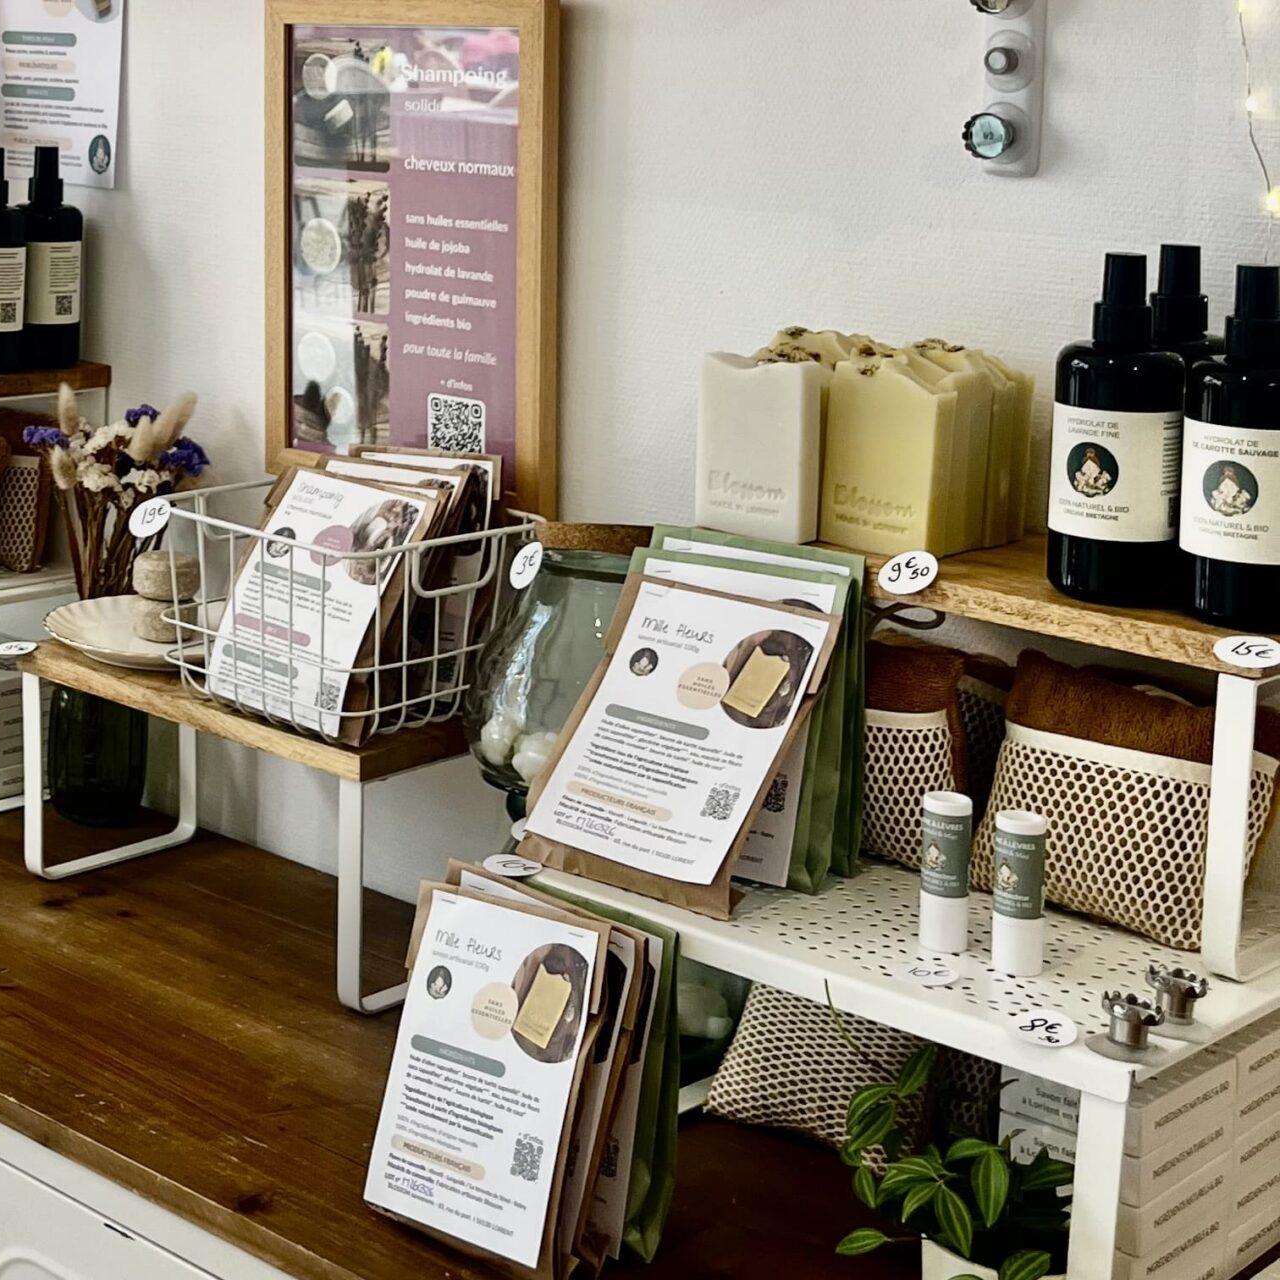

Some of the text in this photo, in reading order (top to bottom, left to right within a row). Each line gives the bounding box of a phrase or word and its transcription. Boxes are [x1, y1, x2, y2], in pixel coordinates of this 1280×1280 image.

[400, 64, 508, 89] Shampoing
[404, 155, 515, 177] cheveux normaux
[405, 213, 509, 233] sans huiles essentielles
[405, 236, 471, 255] huile de jojoba
[405, 261, 494, 283] hydrolat de lavande
[405, 288, 497, 309] poudre de guimauve
[405, 310, 472, 331] ingrédients bio
[402, 342, 497, 366] pour toute la famille
[446, 379, 473, 392] d'infos
[1100, 430, 1120, 439] FINE
[1107, 421, 1119, 430] DE
[1247, 439, 1259, 448] DE
[1238, 448, 1280, 458] SAUVAGE
[141, 503, 169, 525] 19€
[1073, 500, 1130, 514] NATUREL & BIO
[1085, 511, 1119, 522] BRETAGNE
[1208, 518, 1270, 533] NATUREL & BIO
[1223, 530, 1259, 541] BRETAGNE
[516, 550, 539, 575] 3€
[888, 556, 930, 583] 9€50
[641, 616, 715, 644] Mille fleurs
[1232, 641, 1274, 659] 15€
[693, 681, 716, 691] HUILES
[696, 676, 714, 684] SANS
[678, 684, 722, 699] ESSENTIELLES
[581, 787, 657, 817] PRODUCTEURS FRANÇAIS
[435, 929, 502, 961] Mille fleurs
[908, 967, 949, 977] 10€
[484, 1005, 506, 1015] HUILES
[488, 999, 503, 1008] SANS
[471, 1008, 512, 1025] ESSENTIELLES
[1035, 1088, 1079, 1109] Savon fait
[1021, 1097, 1074, 1122] à Lorient en
[1033, 1137, 1059, 1153] Savon
[402, 1141, 472, 1173] PRODUCTEURS FRANÇAIS
